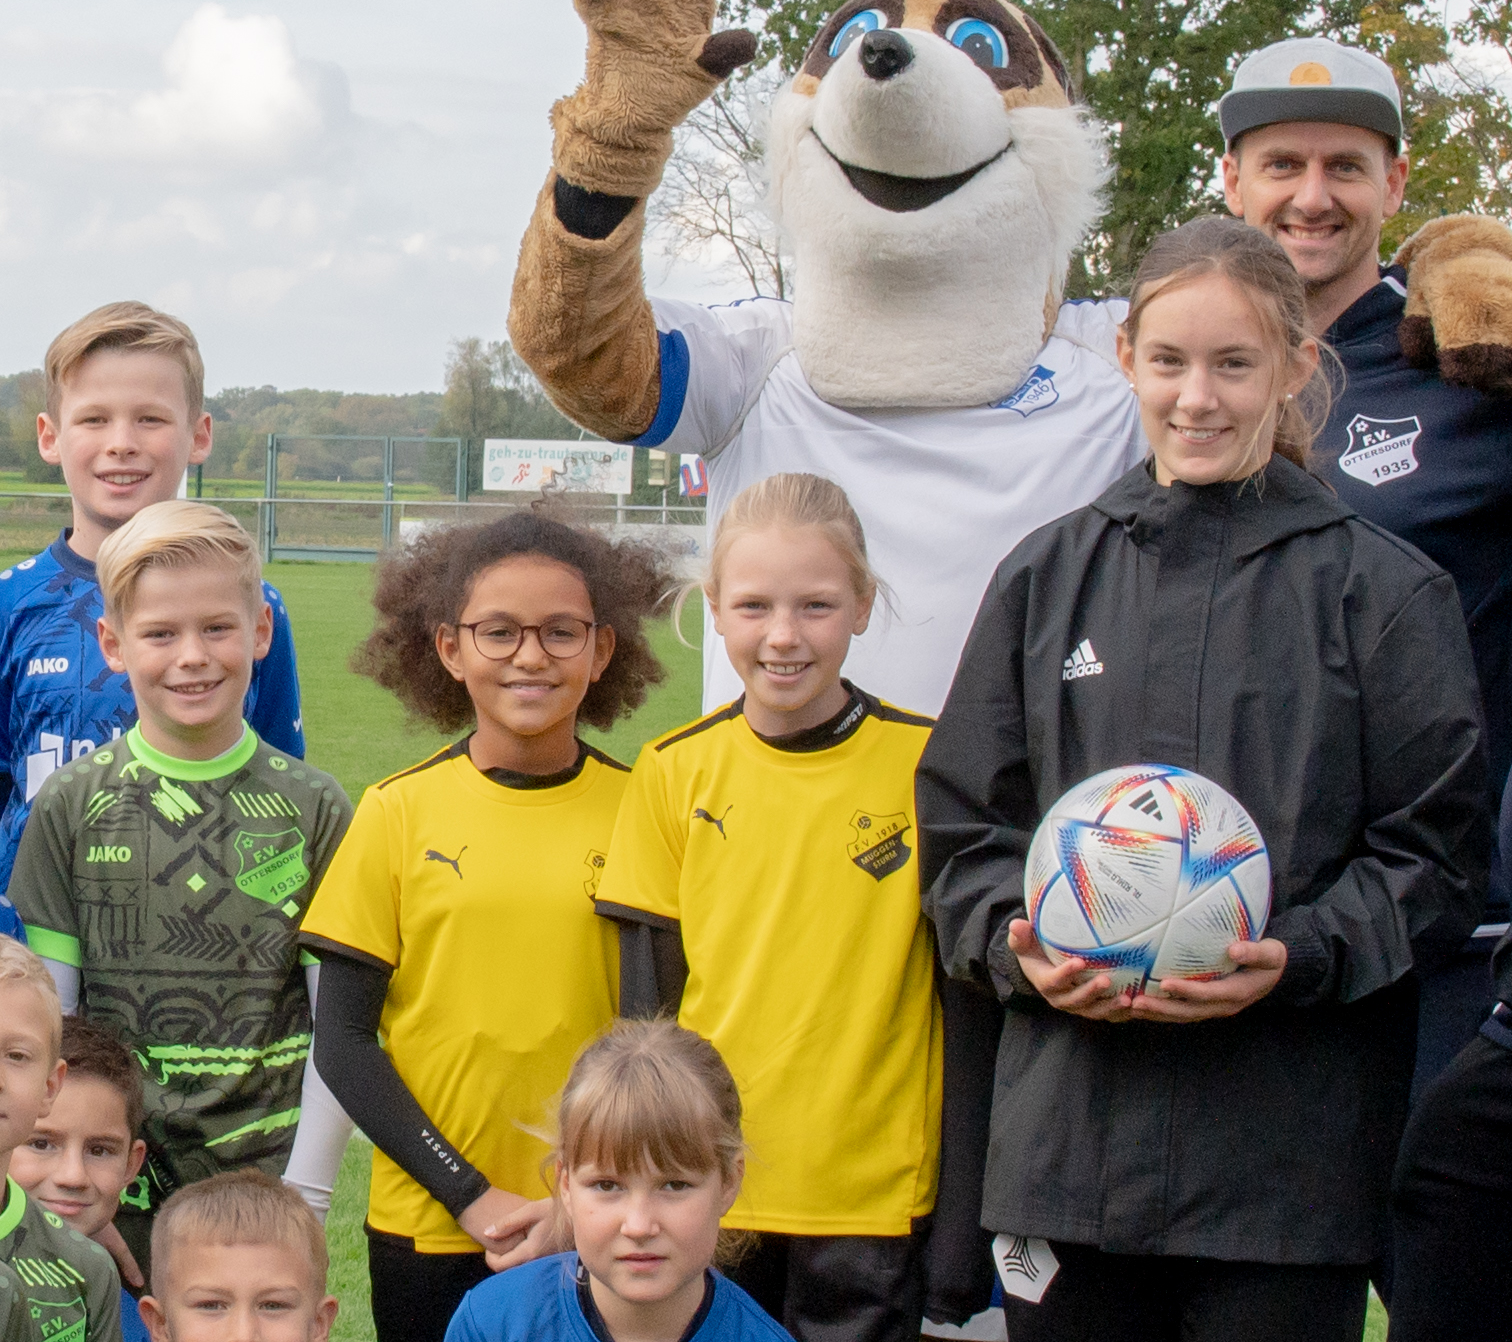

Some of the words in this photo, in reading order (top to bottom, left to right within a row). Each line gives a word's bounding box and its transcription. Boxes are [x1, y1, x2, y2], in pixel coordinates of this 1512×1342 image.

[1023, 382, 1051, 405] 1946
[1362, 429, 1391, 446] F.V.
[1343, 437, 1414, 468] OTTERSDORF
[1372, 459, 1411, 480] 1935
[27, 657, 69, 677] JAKO
[876, 822, 900, 839] 1918
[86, 845, 132, 863] JAKO
[252, 844, 279, 864] F.V.
[872, 850, 898, 869] STURM
[240, 852, 302, 887] OTTERSDORF
[269, 872, 305, 897] 1935
[421, 1128, 460, 1173] KIPSTA
[40, 1315, 68, 1339] F.V.
